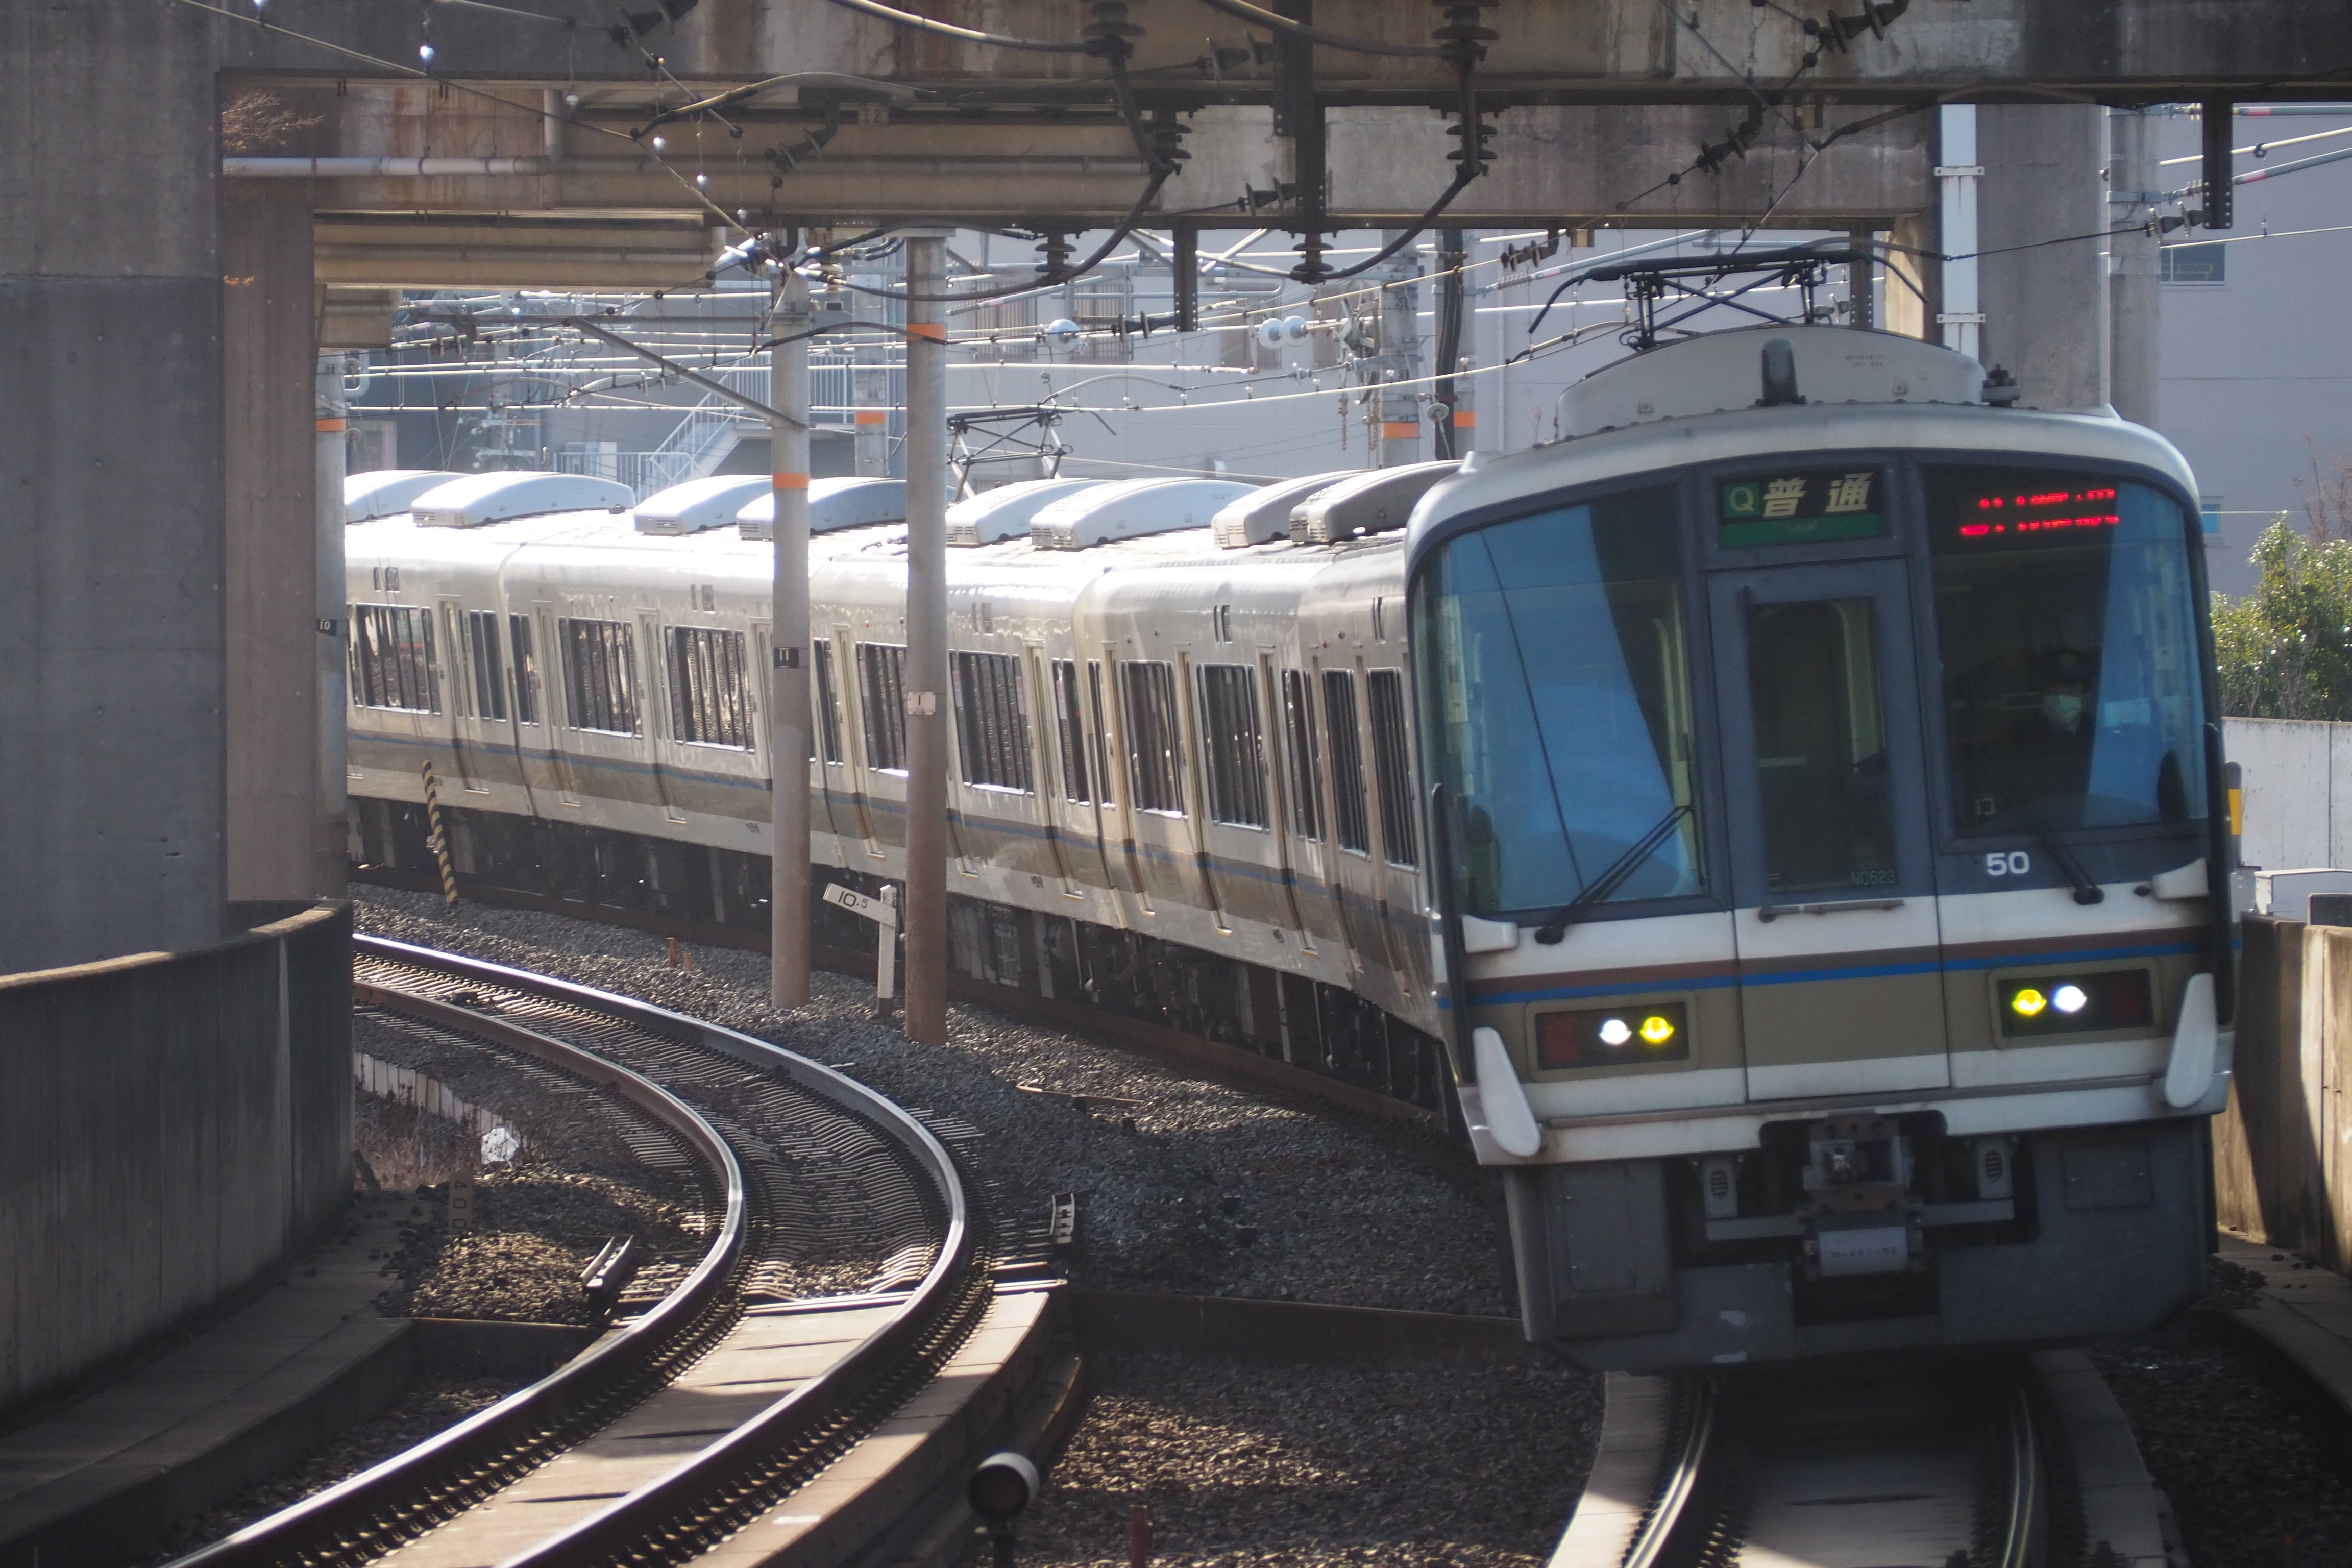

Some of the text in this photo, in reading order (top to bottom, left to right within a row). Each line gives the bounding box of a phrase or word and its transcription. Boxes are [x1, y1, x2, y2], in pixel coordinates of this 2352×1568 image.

[1729, 486, 1754, 512] Q
[1762, 472, 1875, 518] 普通
[320, 620, 331, 630] 10
[1986, 851, 2030, 876] 50
[1851, 869, 1896, 885] NC623
[838, 890, 869, 908] 10.5
[452, 1180, 468, 1229] 400
